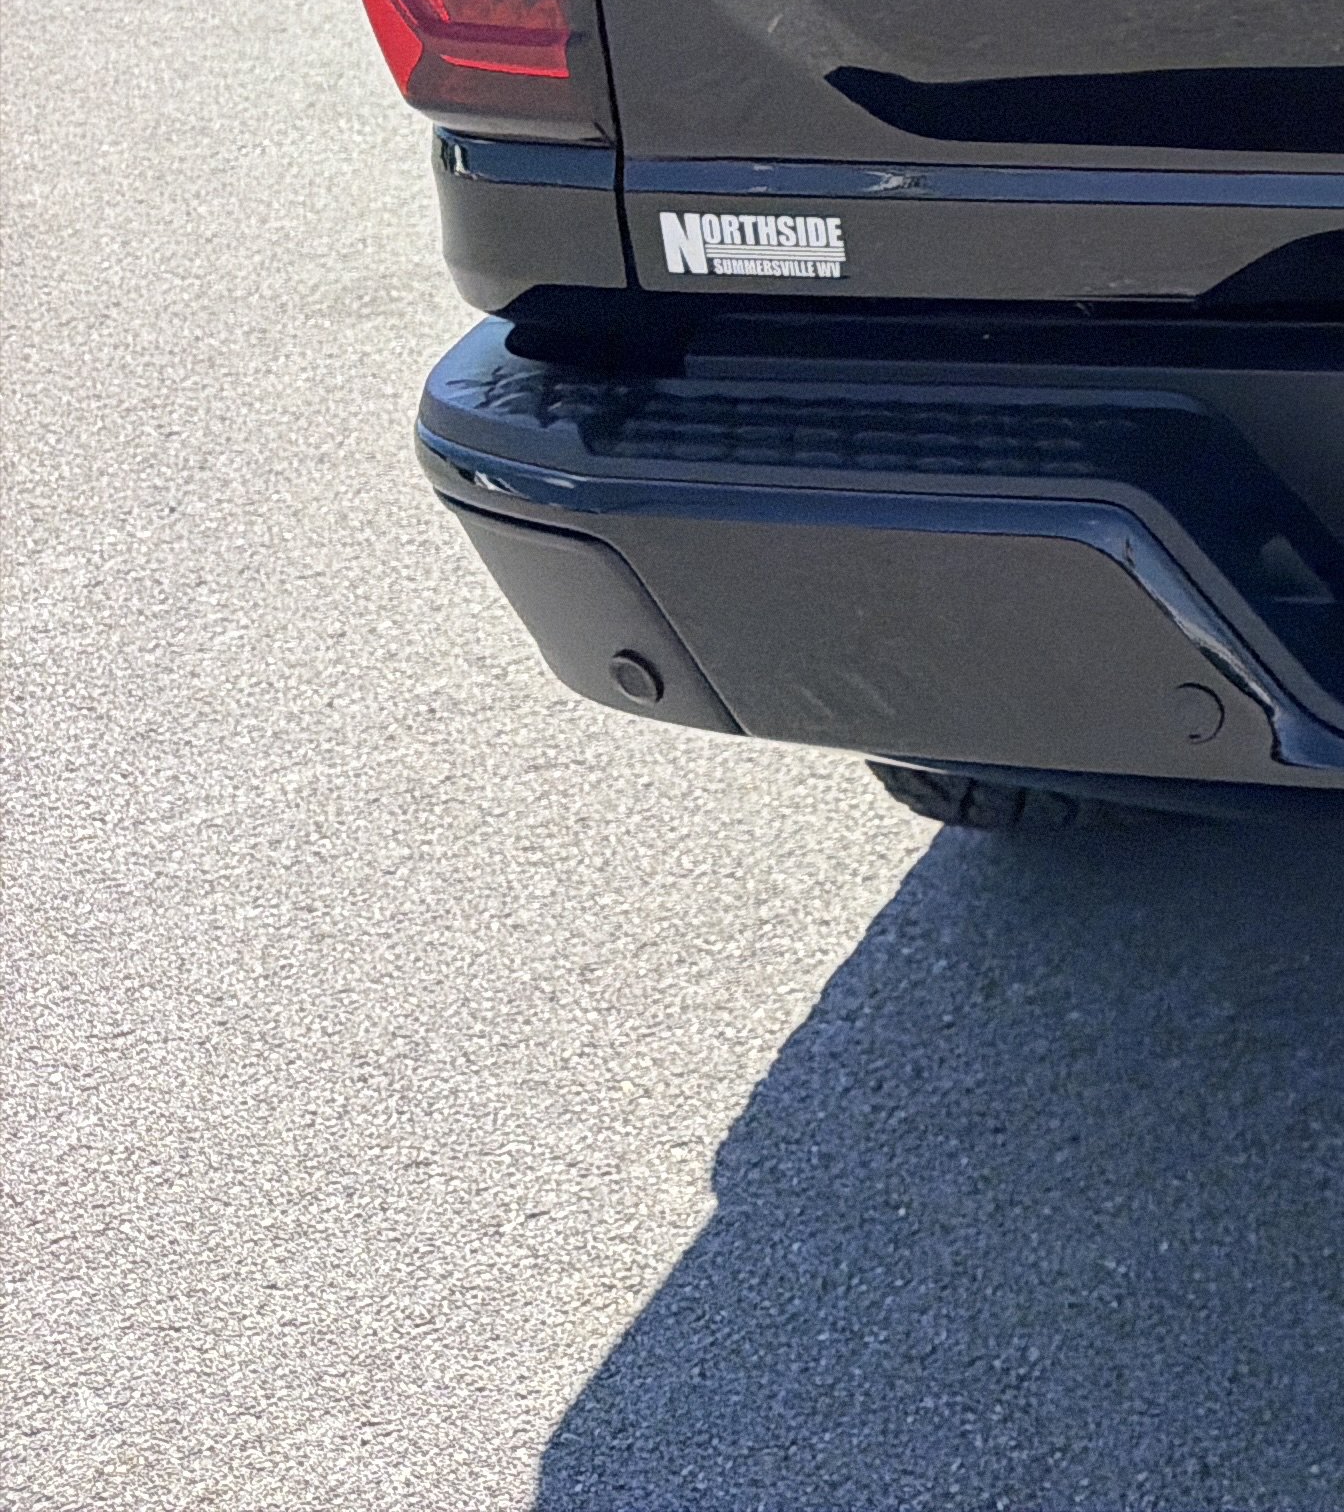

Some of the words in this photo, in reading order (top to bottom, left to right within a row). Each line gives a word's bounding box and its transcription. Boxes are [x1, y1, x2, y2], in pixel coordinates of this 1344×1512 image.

[659, 211, 845, 274] NORTHSIDE
[713, 258, 815, 277] SUMMERSVILLE
[816, 261, 841, 278] WV
